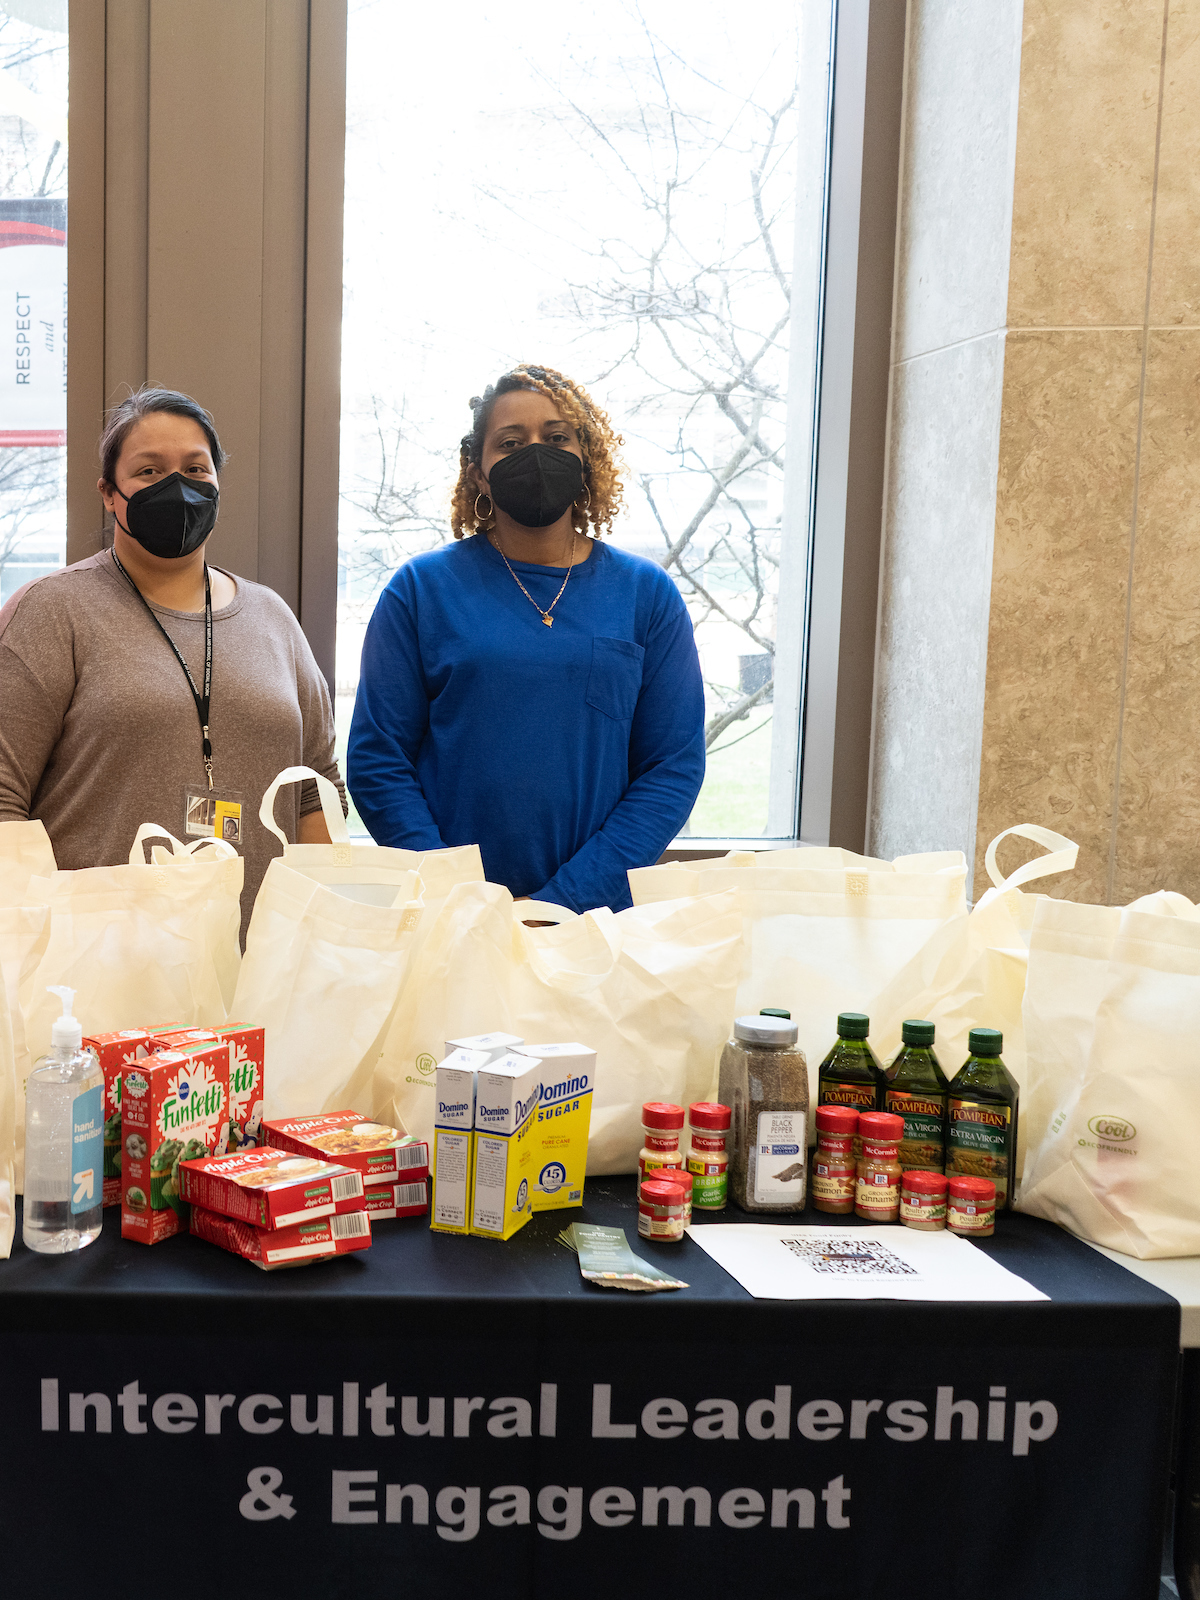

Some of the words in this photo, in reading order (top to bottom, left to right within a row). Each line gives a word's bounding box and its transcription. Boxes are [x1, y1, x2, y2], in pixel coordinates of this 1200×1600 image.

[16, 291, 31, 385] RESPECT
[39, 320, 54, 352] and
[125, 1078, 148, 1089] Funfetti
[825, 1091, 873, 1106] POMPEIAN
[162, 1085, 221, 1132] Funfetti
[438, 1101, 469, 1112] Domino
[479, 1105, 509, 1117] Domino
[515, 1085, 539, 1126] Domino
[537, 1100, 580, 1122] SUGAR
[891, 1101, 941, 1115] POMPEIAN
[280, 1120, 323, 1132] Apple
[323, 1114, 366, 1123] Crisp
[771, 1119, 793, 1127] BLACK
[953, 1109, 1004, 1126] POMPEIAN
[74, 1118, 94, 1133] hand
[771, 1126, 793, 1134] PEPPER
[914, 1123, 942, 1133] VIRGIN
[1095, 1119, 1130, 1138] Cool
[74, 1126, 102, 1144] sanitizer
[695, 1137, 724, 1146] McCormick
[950, 1128, 975, 1140] EXTRA
[976, 1133, 1005, 1144] VIRGIN
[821, 1140, 844, 1149] Cormick
[962, 1140, 978, 1148] OLIVE
[865, 1146, 898, 1156] McCormick
[201, 1157, 244, 1173] Apple
[242, 1150, 287, 1164] Crisp
[545, 1168, 560, 1179] 15
[696, 1174, 727, 1186] ORGANIC
[699, 1195, 722, 1203] Powder
[702, 1190, 721, 1198] Garlic
[860, 1193, 899, 1203] Cinnamon
[904, 1206, 927, 1215] Poultry
[40, 1378, 558, 1440] Intercultural
[591, 1385, 1060, 1457] Leadership
[238, 1465, 298, 1522] &
[331, 1470, 852, 1542] Engagement
